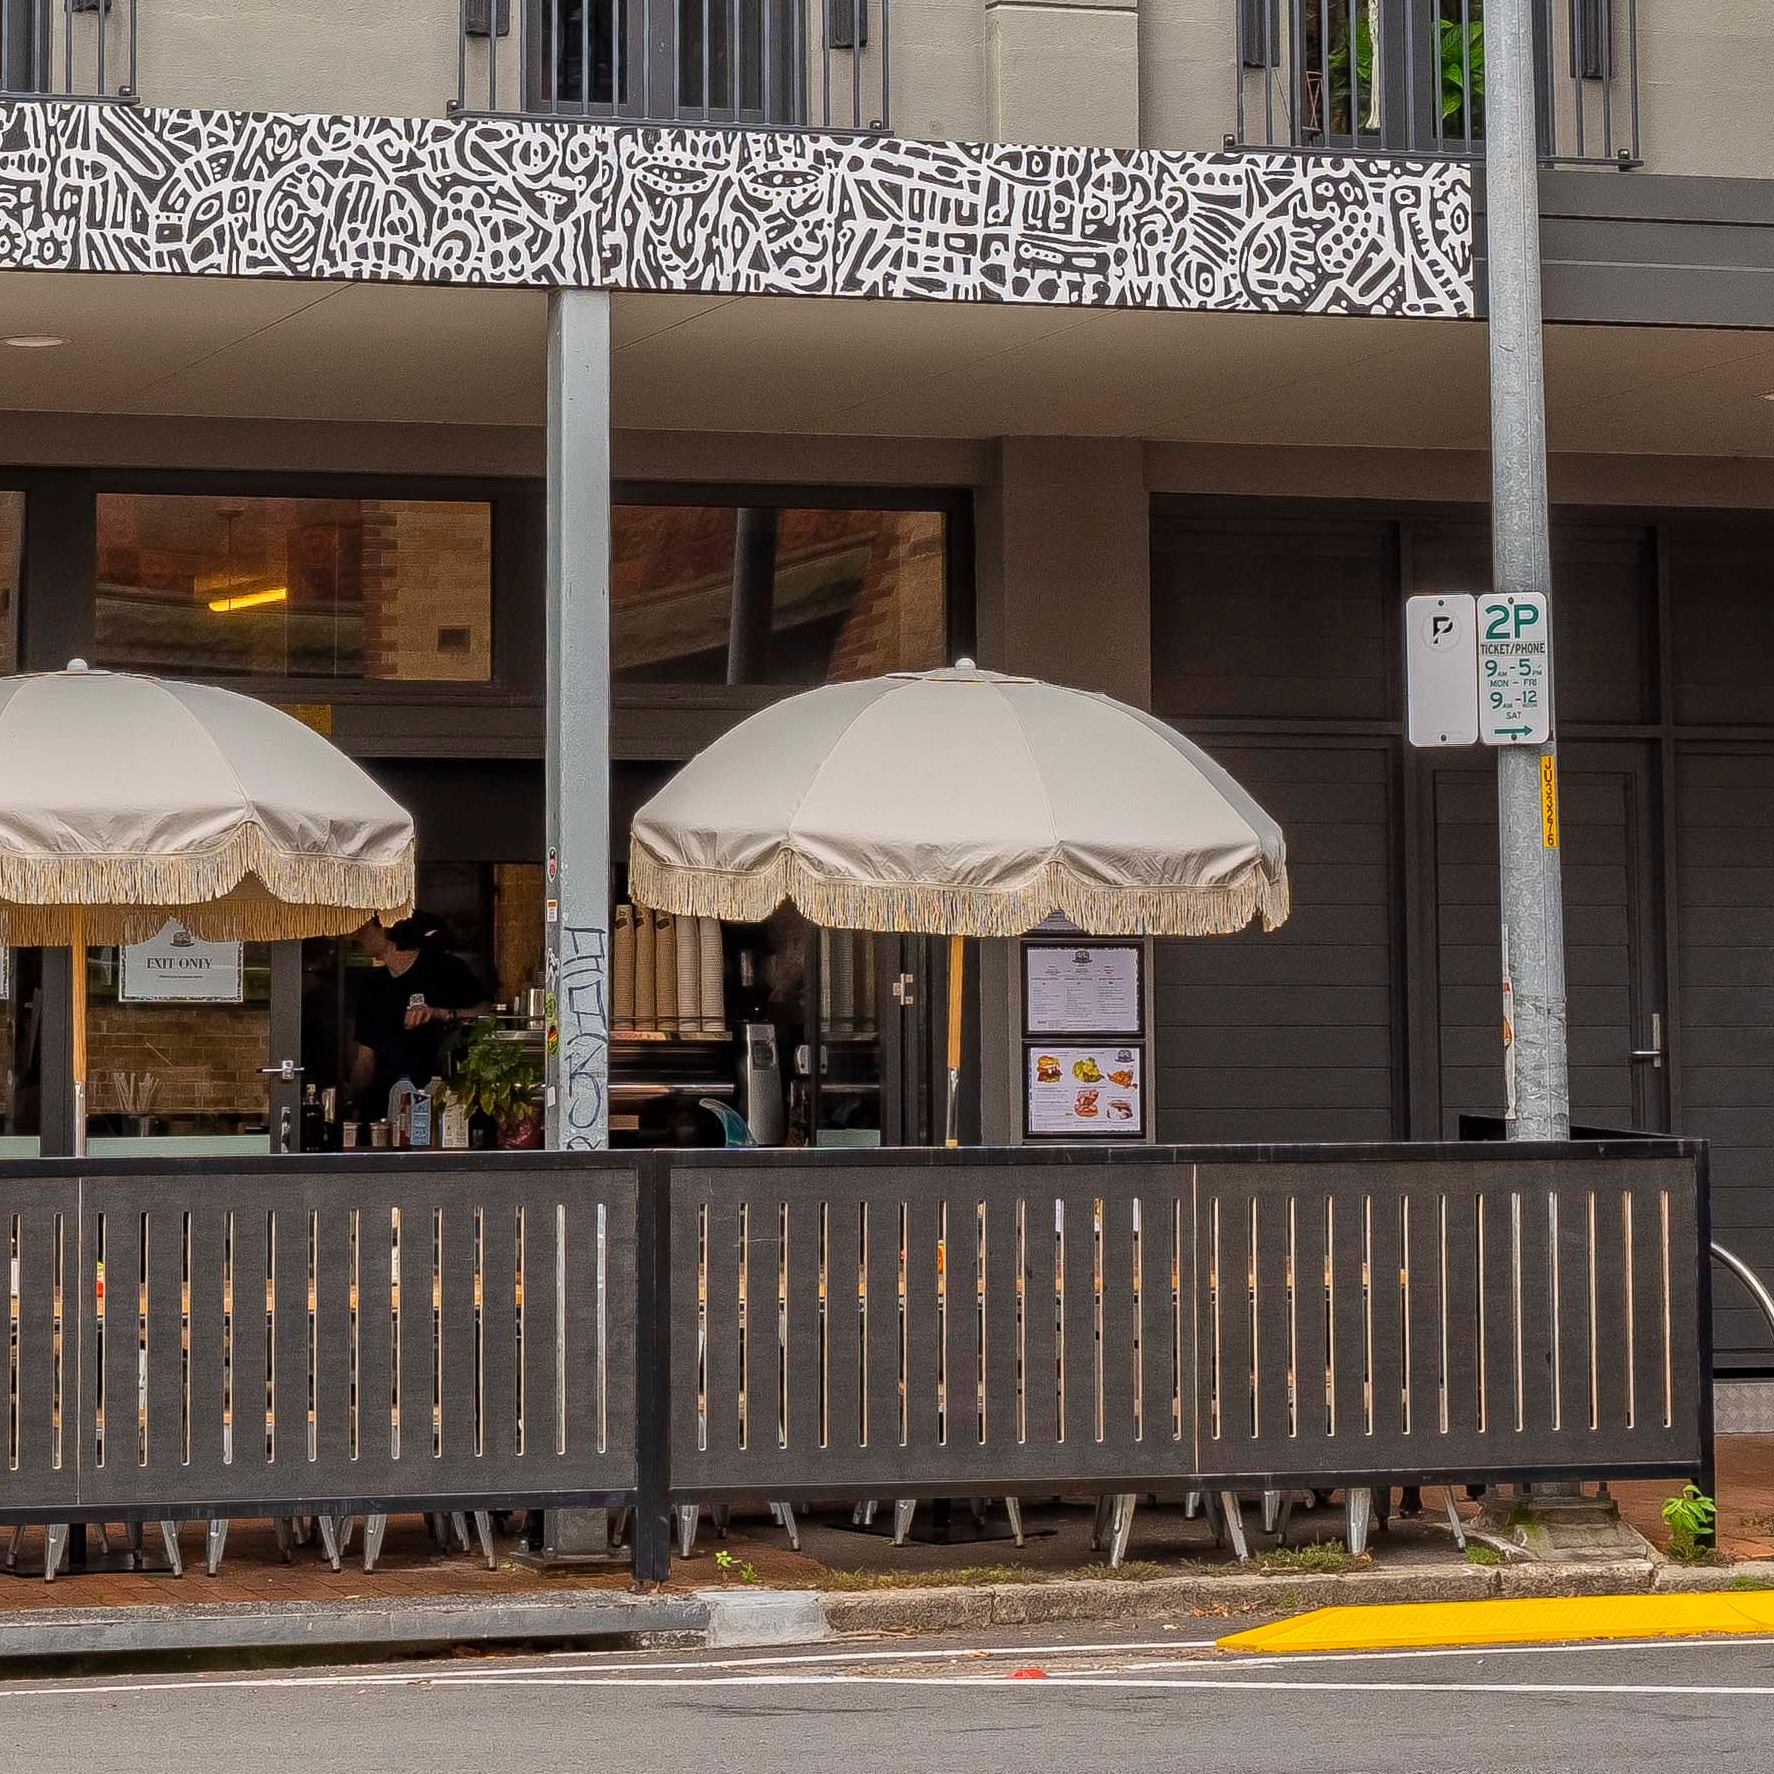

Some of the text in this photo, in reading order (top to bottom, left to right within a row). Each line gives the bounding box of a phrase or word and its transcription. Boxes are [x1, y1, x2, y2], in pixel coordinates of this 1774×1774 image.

[1485, 604, 1539, 639] 2P
[1480, 642, 1546, 655] TICKET/PHONE
[1490, 679, 1509, 687] MON
[1523, 678, 1537, 687] FRI
[1505, 711, 1522, 720] SAT
[146, 957, 213, 970] EXIT ONLY
